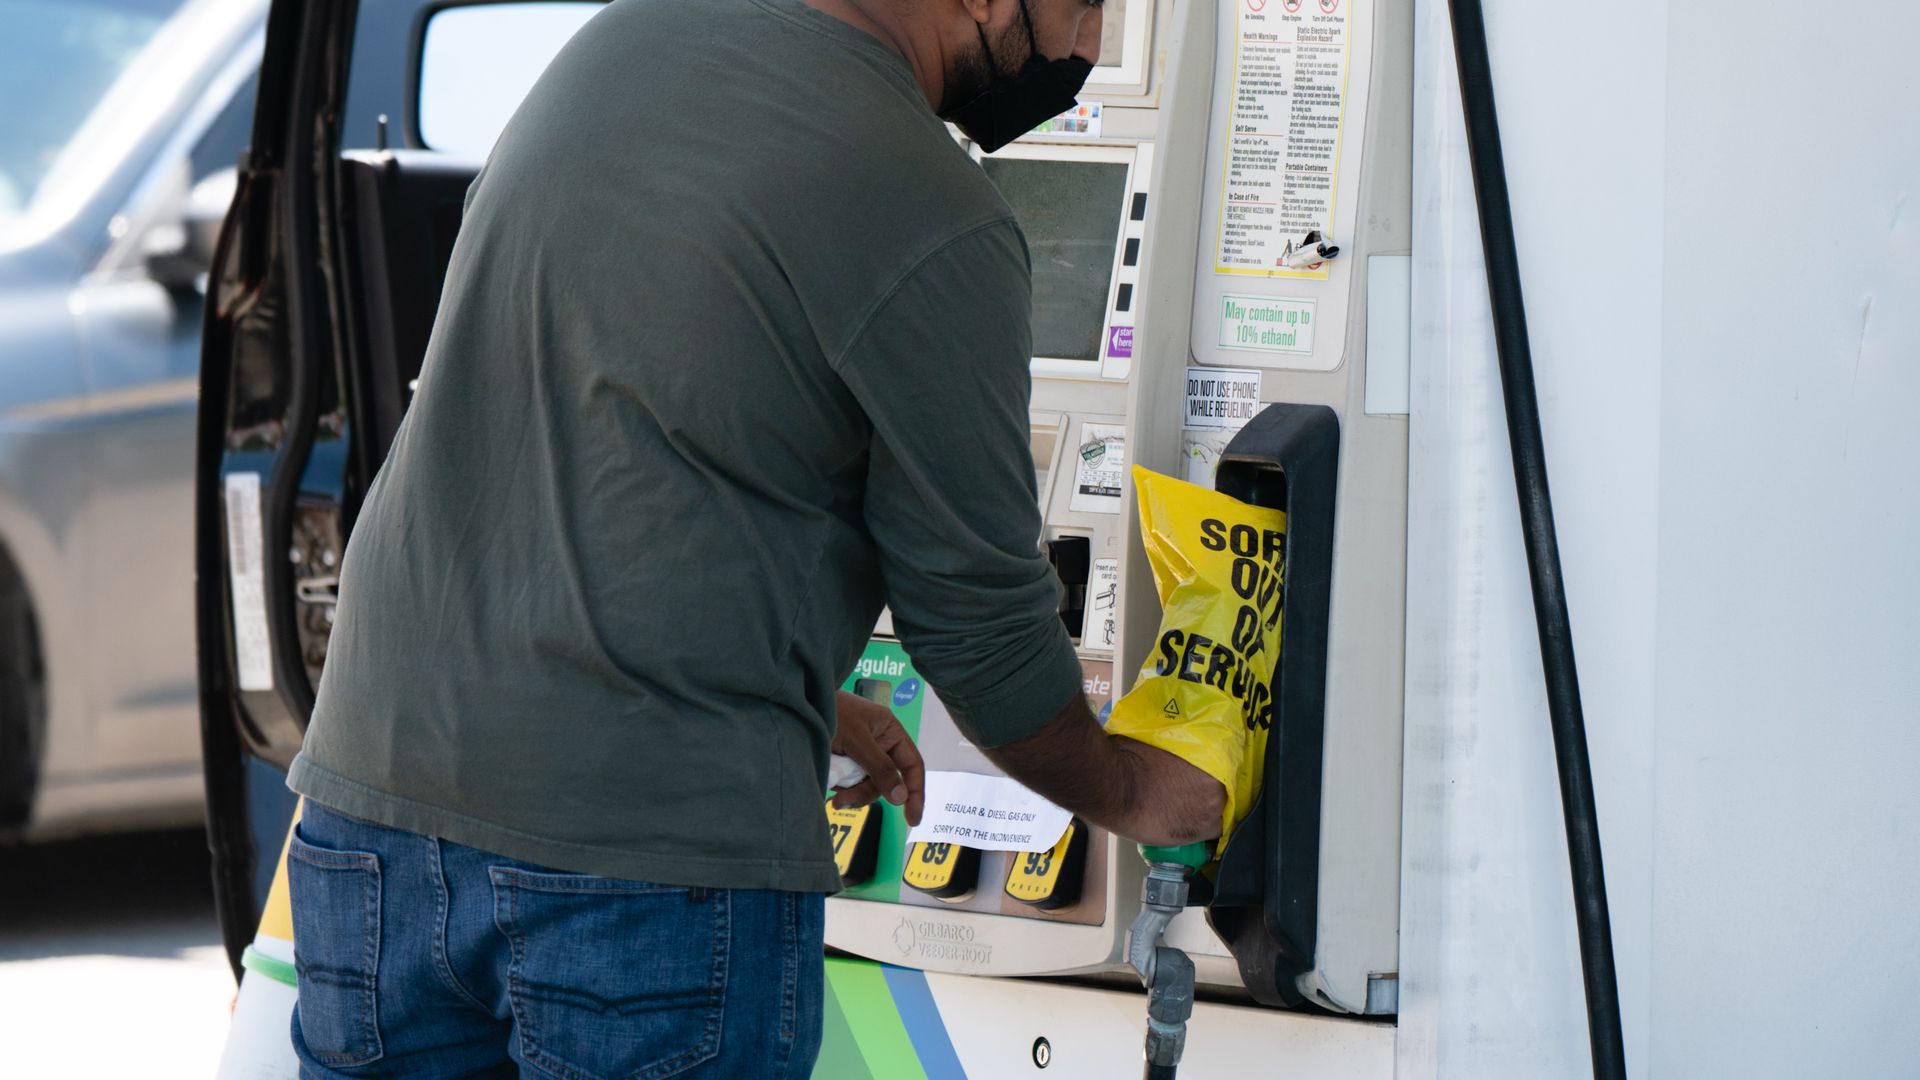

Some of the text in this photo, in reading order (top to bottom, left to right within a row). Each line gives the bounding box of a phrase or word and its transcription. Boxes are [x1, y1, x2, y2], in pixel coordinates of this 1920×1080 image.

[1258, 33, 1278, 42] Warnings
[1297, 26, 1341, 36] Static Electric Spark
[1297, 34, 1317, 42] Explosion
[1235, 124, 1244, 132] Self
[1286, 162, 1328, 172] Portable Containers
[1225, 301, 1310, 326] May contain up to
[1237, 325, 1297, 346] 10% ethanol
[1188, 379, 1257, 399] DO NOT USE PHONE
[1190, 400, 1252, 419] WHILE REFUELING
[1200, 518, 1286, 564] SOR
[854, 656, 906, 678] egular
[945, 803, 1037, 822] REGULAR & DIESEL GAS ONLY
[933, 824, 1032, 844] SORRY FOR THE INCONVENIENCE
[922, 842, 952, 865] 89
[1024, 849, 1054, 877] 93
[919, 921, 975, 942] GILBARCO
[919, 943, 992, 964] VEEDER-ROOT
